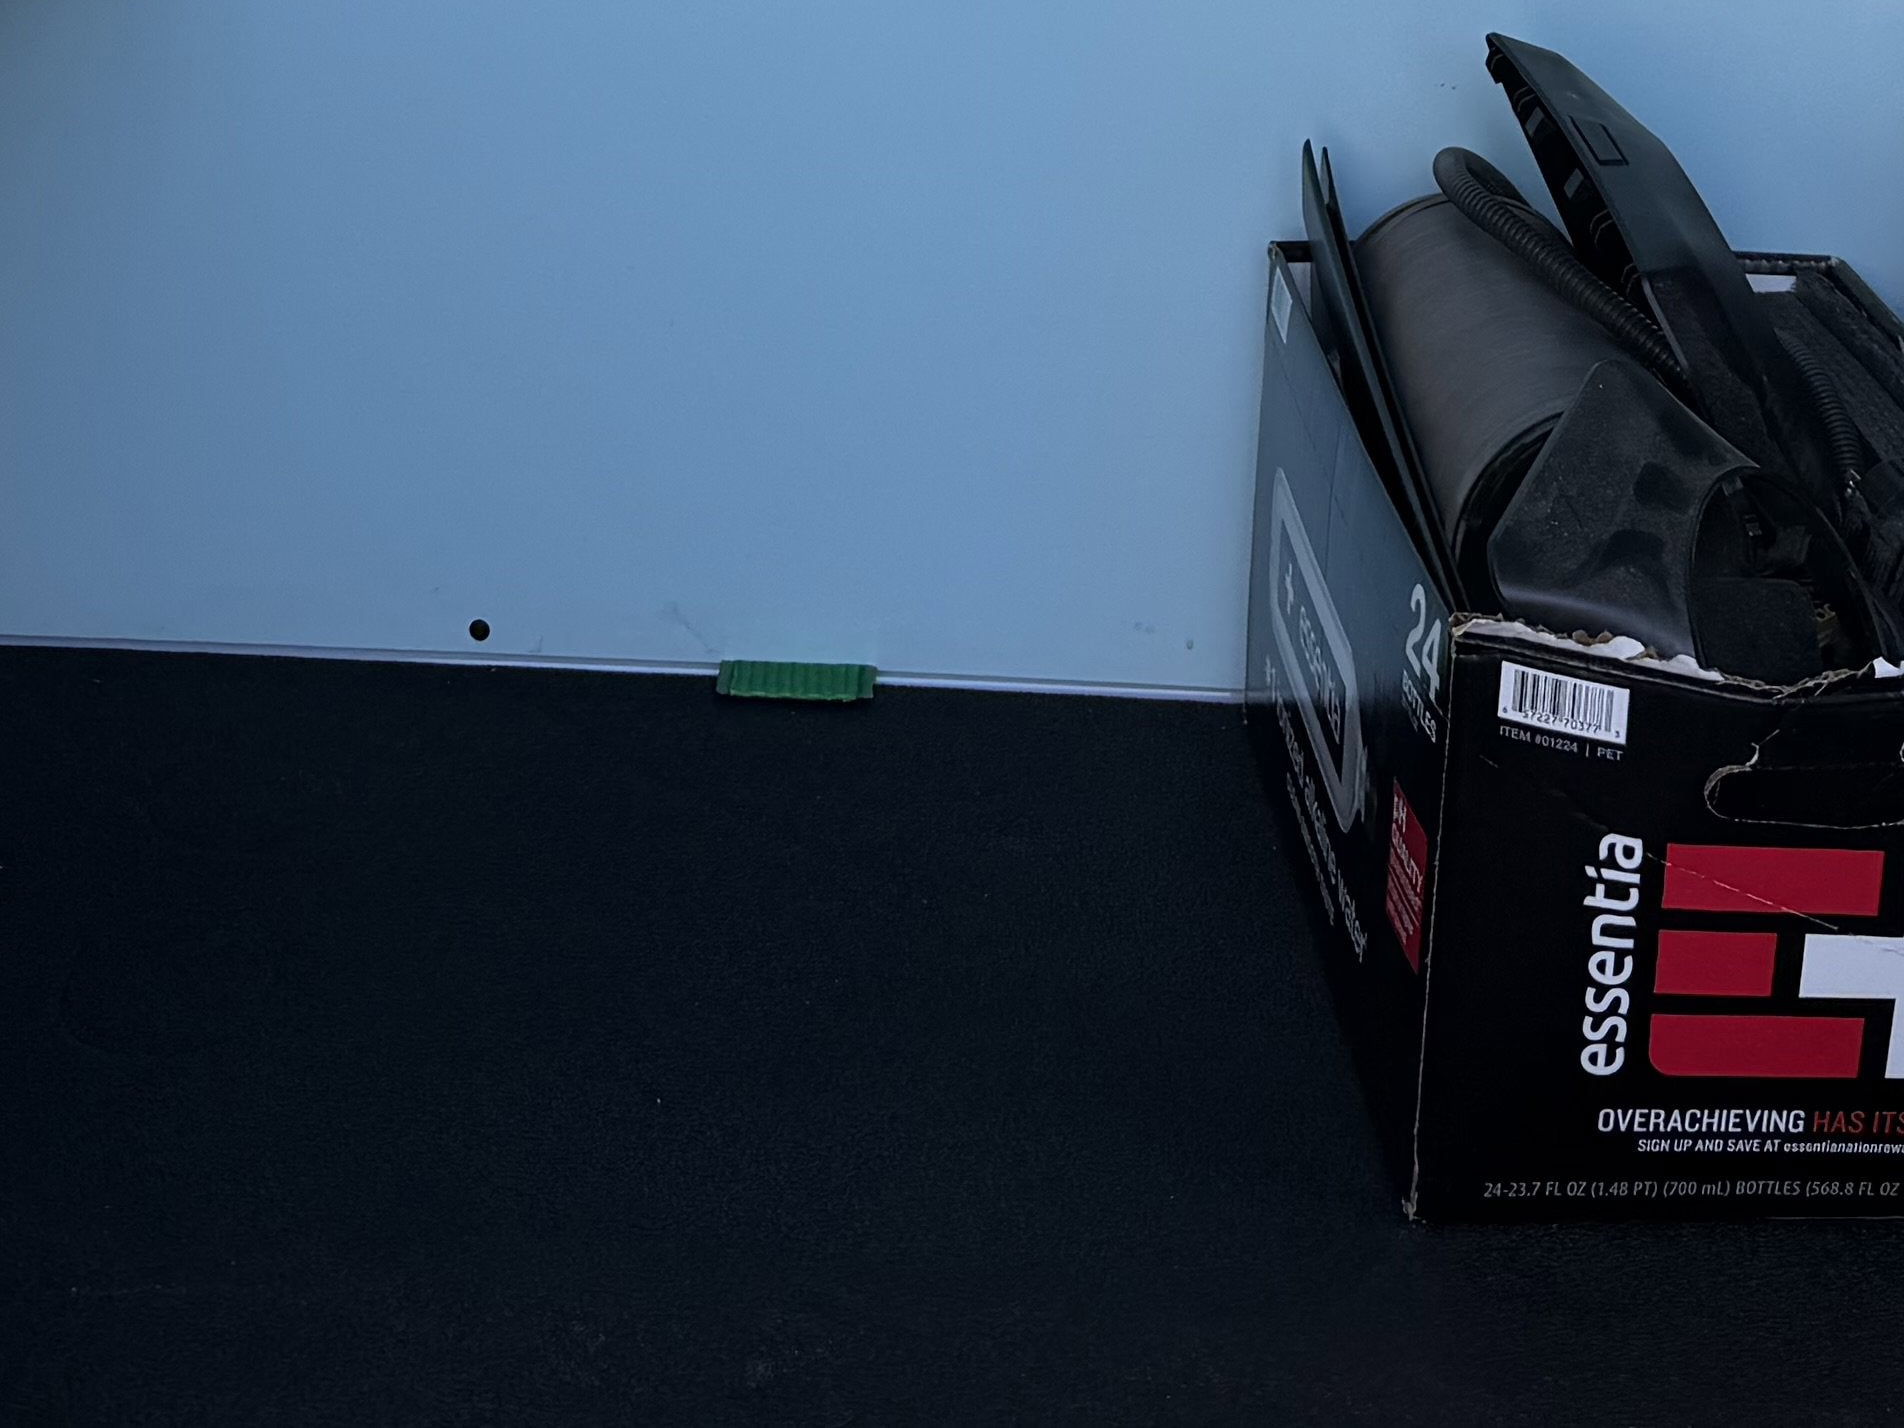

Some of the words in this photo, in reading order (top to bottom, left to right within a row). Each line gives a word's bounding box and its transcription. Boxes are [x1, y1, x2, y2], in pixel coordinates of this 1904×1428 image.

[1405, 583, 1442, 705] 24
[1499, 725, 1531, 743] ITEM
[1535, 734, 1579, 753] #01224
[1597, 746, 1624, 761] PET
[1597, 1108, 1806, 1133] OVERACHIEVING
[1812, 1110, 1865, 1134] HAS
[1637, 1138, 1670, 1152] SIGN
[1673, 1139, 1692, 1152] UP
[1695, 1139, 1724, 1152] AND
[1726, 1139, 1761, 1152] SAVE
[1763, 1139, 1782, 1152] AT
[1483, 1181, 1542, 1198] 24-23.7
[1545, 1181, 1562, 1196] FL
[1567, 1181, 1587, 1196] OZ
[1591, 1181, 1628, 1198] (1.48
[1633, 1181, 1658, 1198] PT)
[1663, 1181, 1696, 1198] (700
[1700, 1181, 1731, 1197] mL)
[1736, 1181, 1801, 1195] BOTTLES
[1806, 1181, 1854, 1197] (568.8
[1858, 1181, 1874, 1196] FL
[1880, 1181, 1900, 1196] OZ
